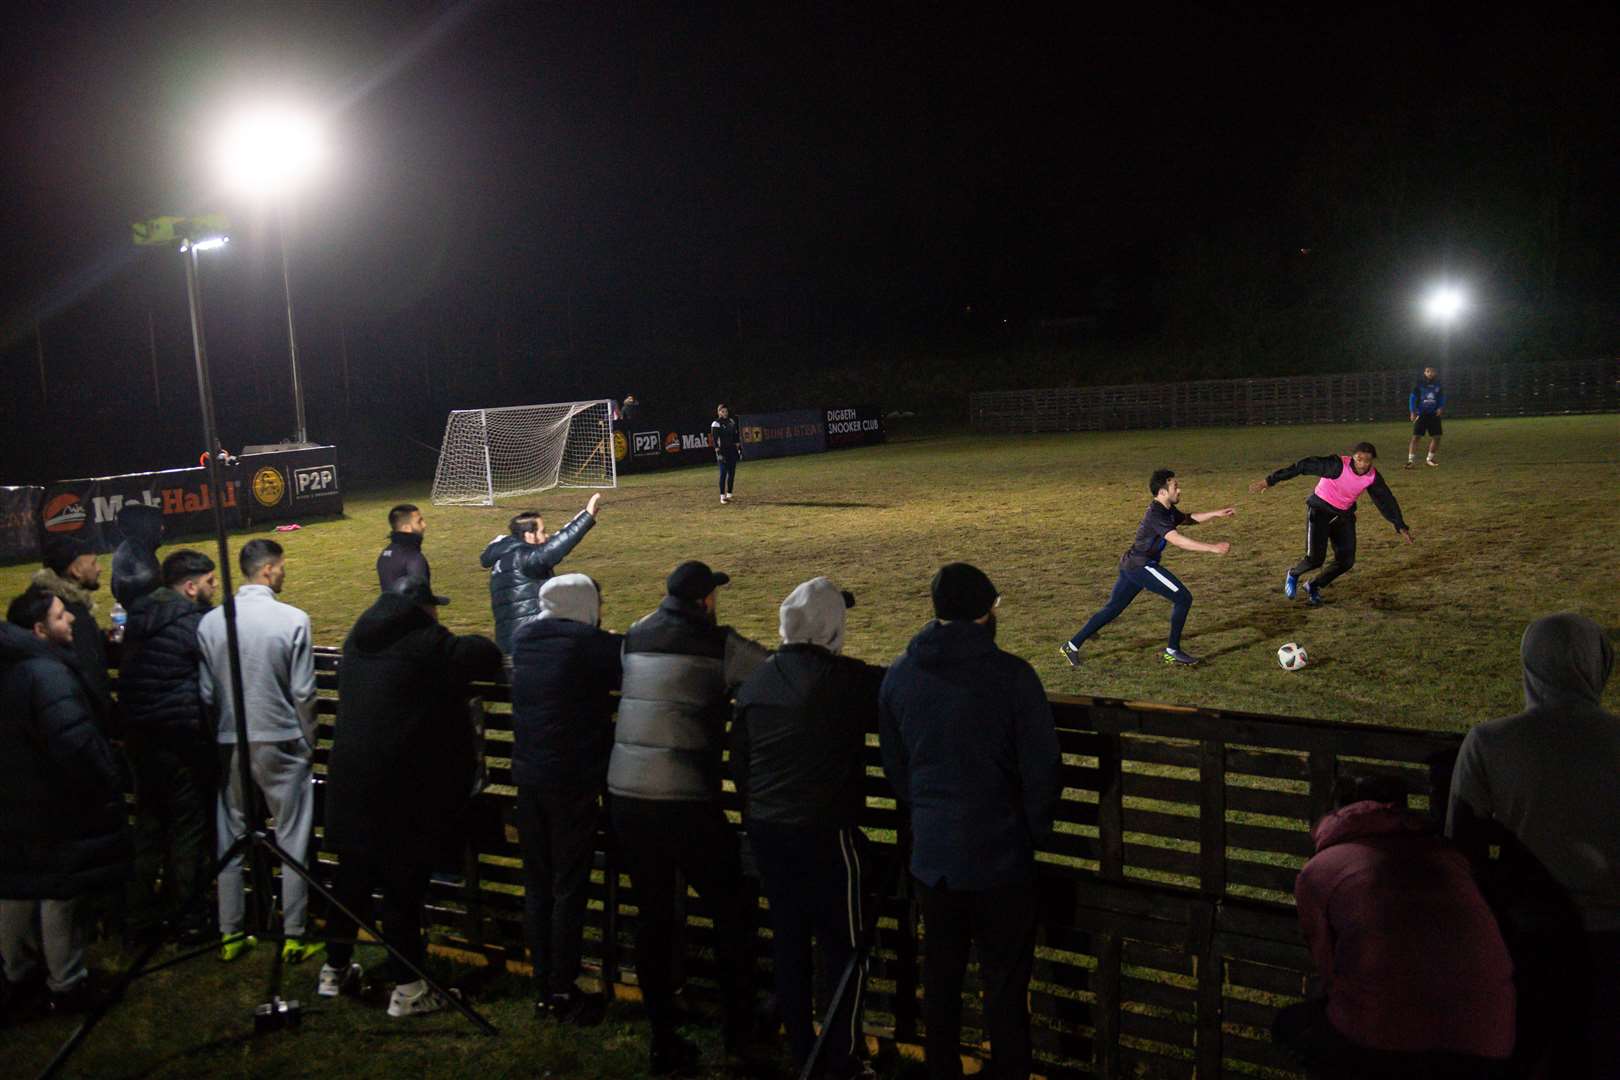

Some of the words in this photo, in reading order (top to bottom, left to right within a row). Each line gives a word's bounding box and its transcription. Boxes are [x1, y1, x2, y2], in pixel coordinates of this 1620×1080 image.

[828, 421, 861, 434] SNOOKER
[863, 419, 878, 431] CLUB
[635, 435, 657, 451] P2P
[298, 470, 332, 492] P2P
[92, 480, 237, 523] MkHall
